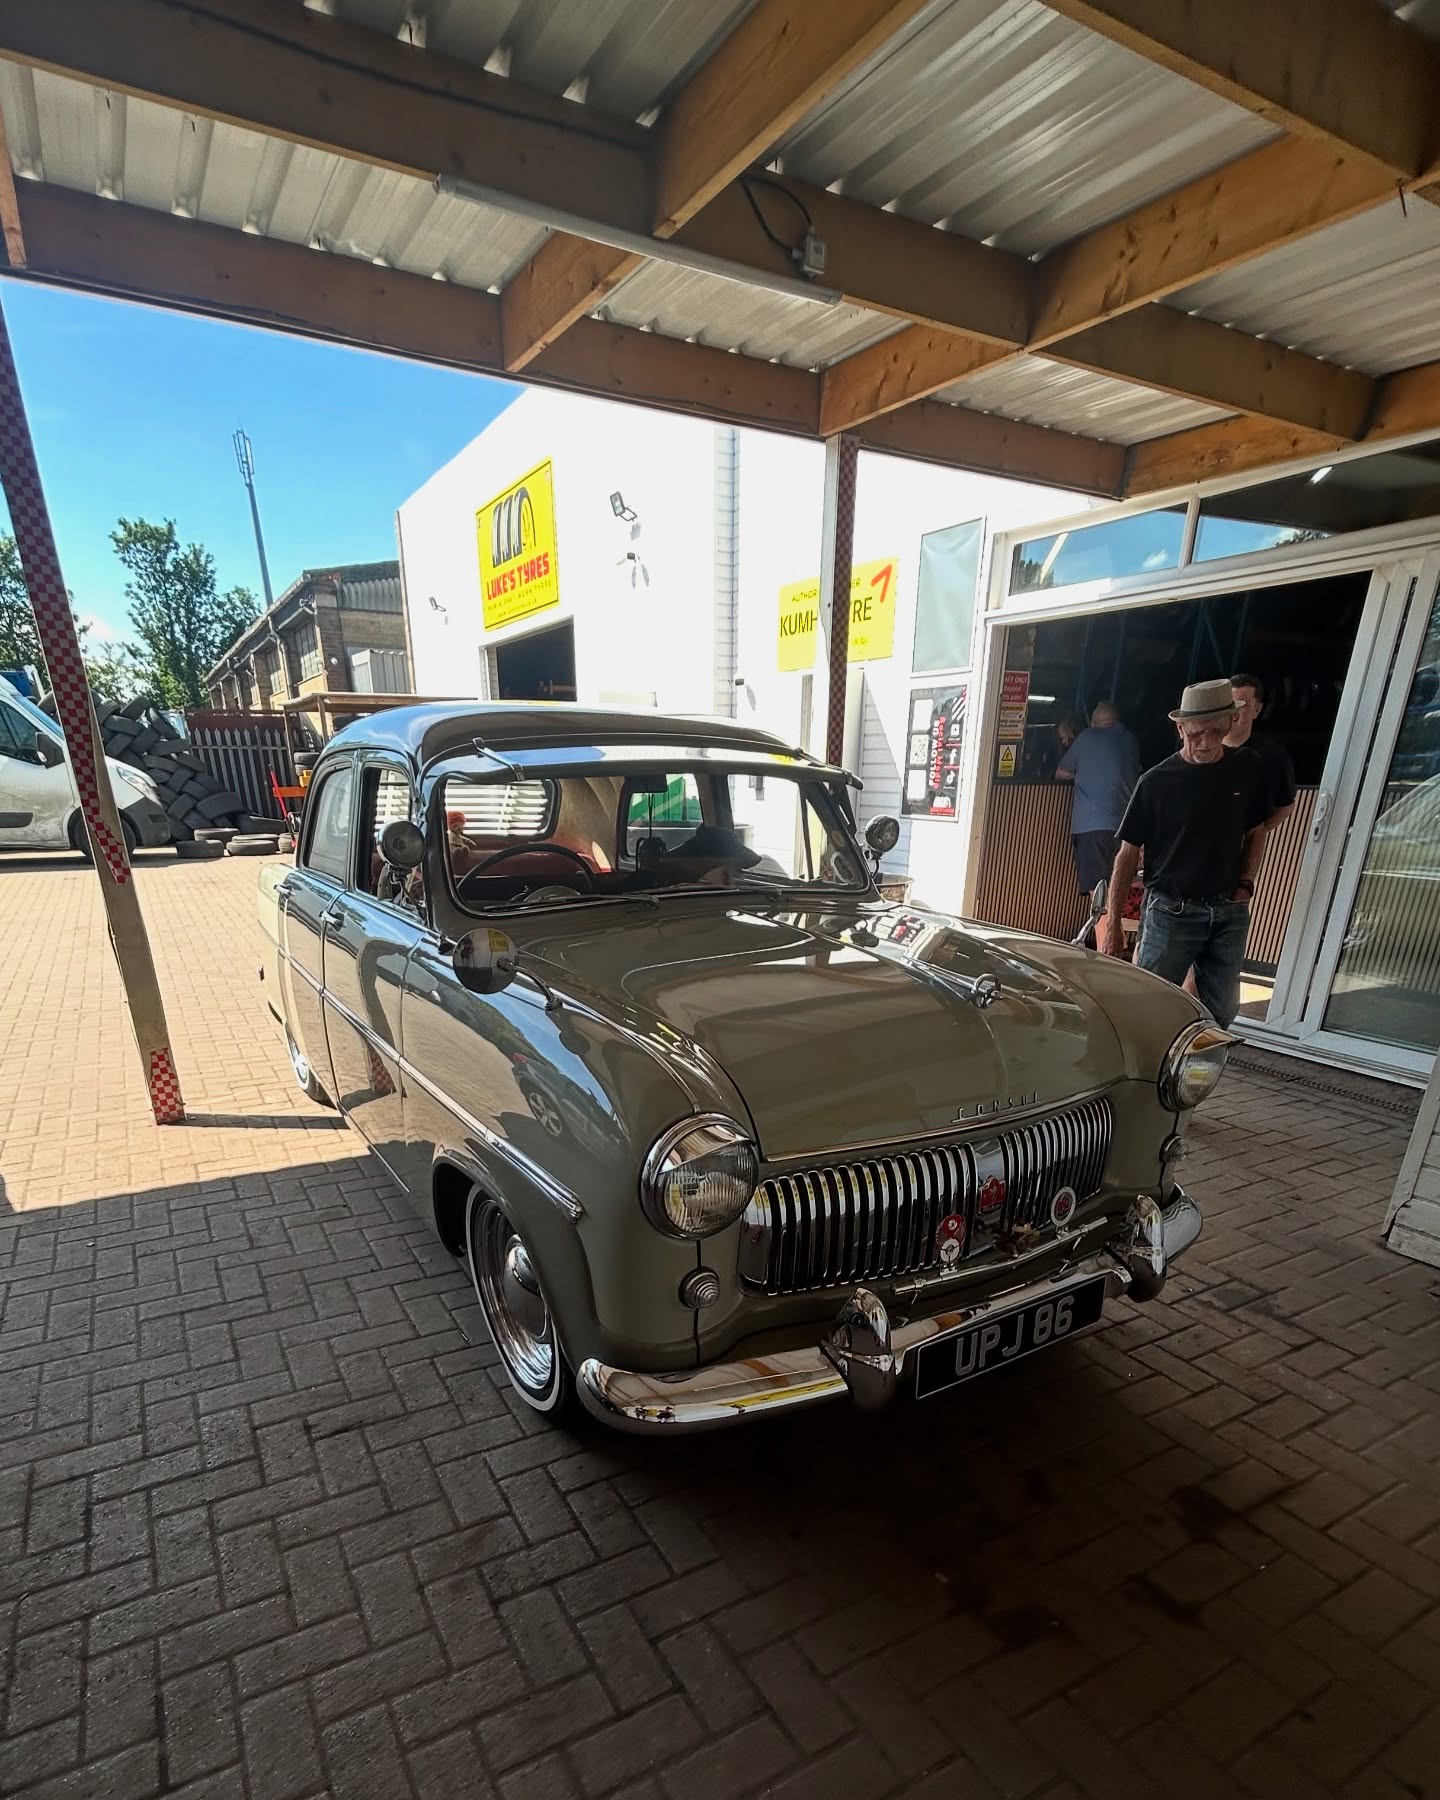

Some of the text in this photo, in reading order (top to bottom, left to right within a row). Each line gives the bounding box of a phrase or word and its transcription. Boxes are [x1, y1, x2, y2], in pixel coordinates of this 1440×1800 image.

[486, 551, 550, 601] LUKE'S TYRES
[791, 589, 818, 603] AUTHOR
[780, 596, 873, 638] KUMH RE
[929, 720, 940, 786] FOLLOW US
[955, 1295, 1075, 1377] UPJ 86
